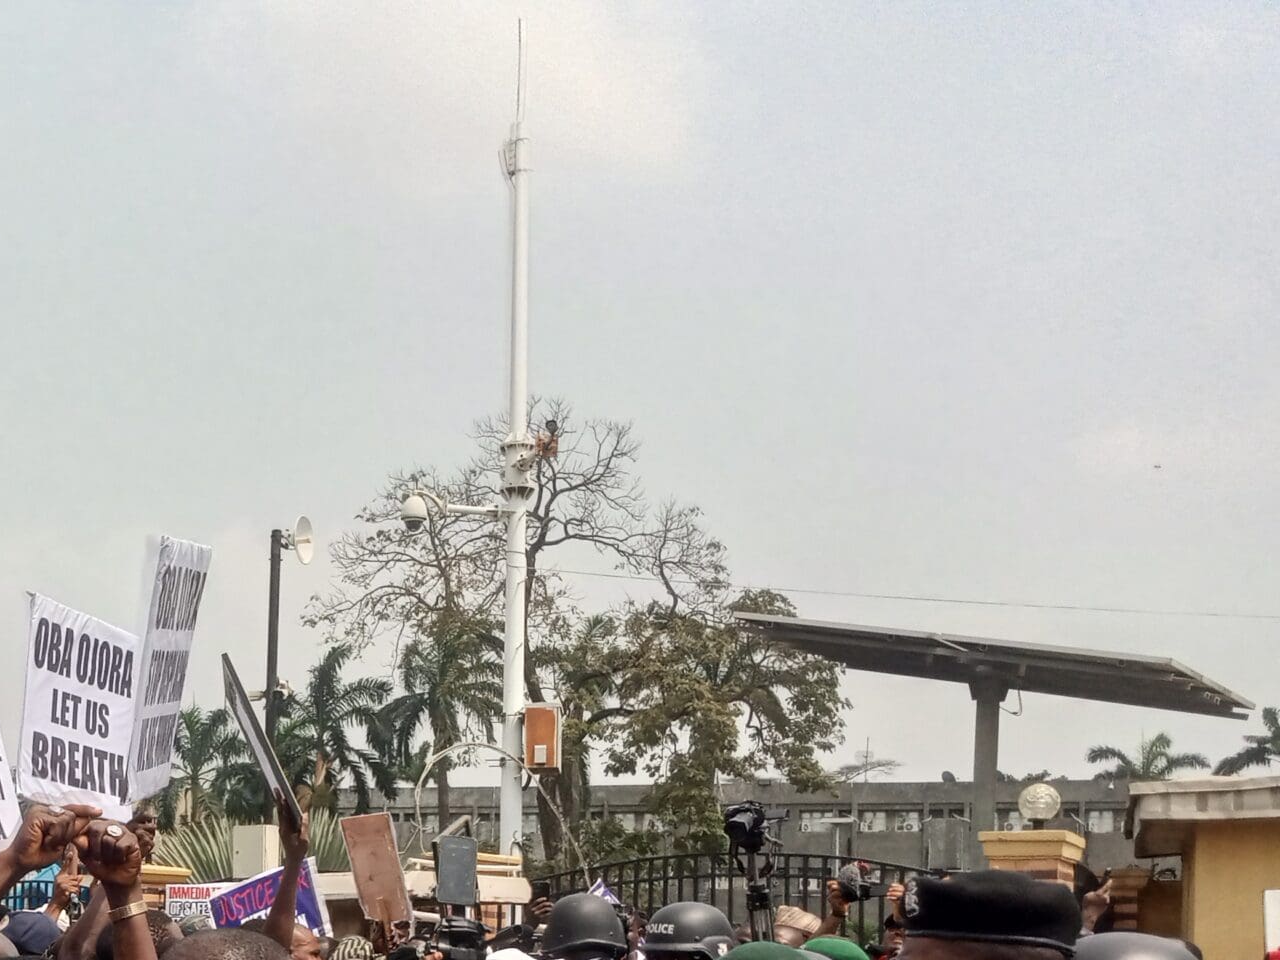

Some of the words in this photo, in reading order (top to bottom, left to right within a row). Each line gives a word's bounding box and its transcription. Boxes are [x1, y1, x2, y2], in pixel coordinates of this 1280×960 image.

[34, 617, 74, 679] OBA
[76, 633, 134, 699] OJORA
[51, 688, 82, 730] LET
[85, 698, 110, 738] US
[32, 731, 129, 806] BREATH
[169, 886, 221, 899] IMMEDIA
[169, 901, 183, 915] OF
[220, 879, 276, 925] JUSTICE
